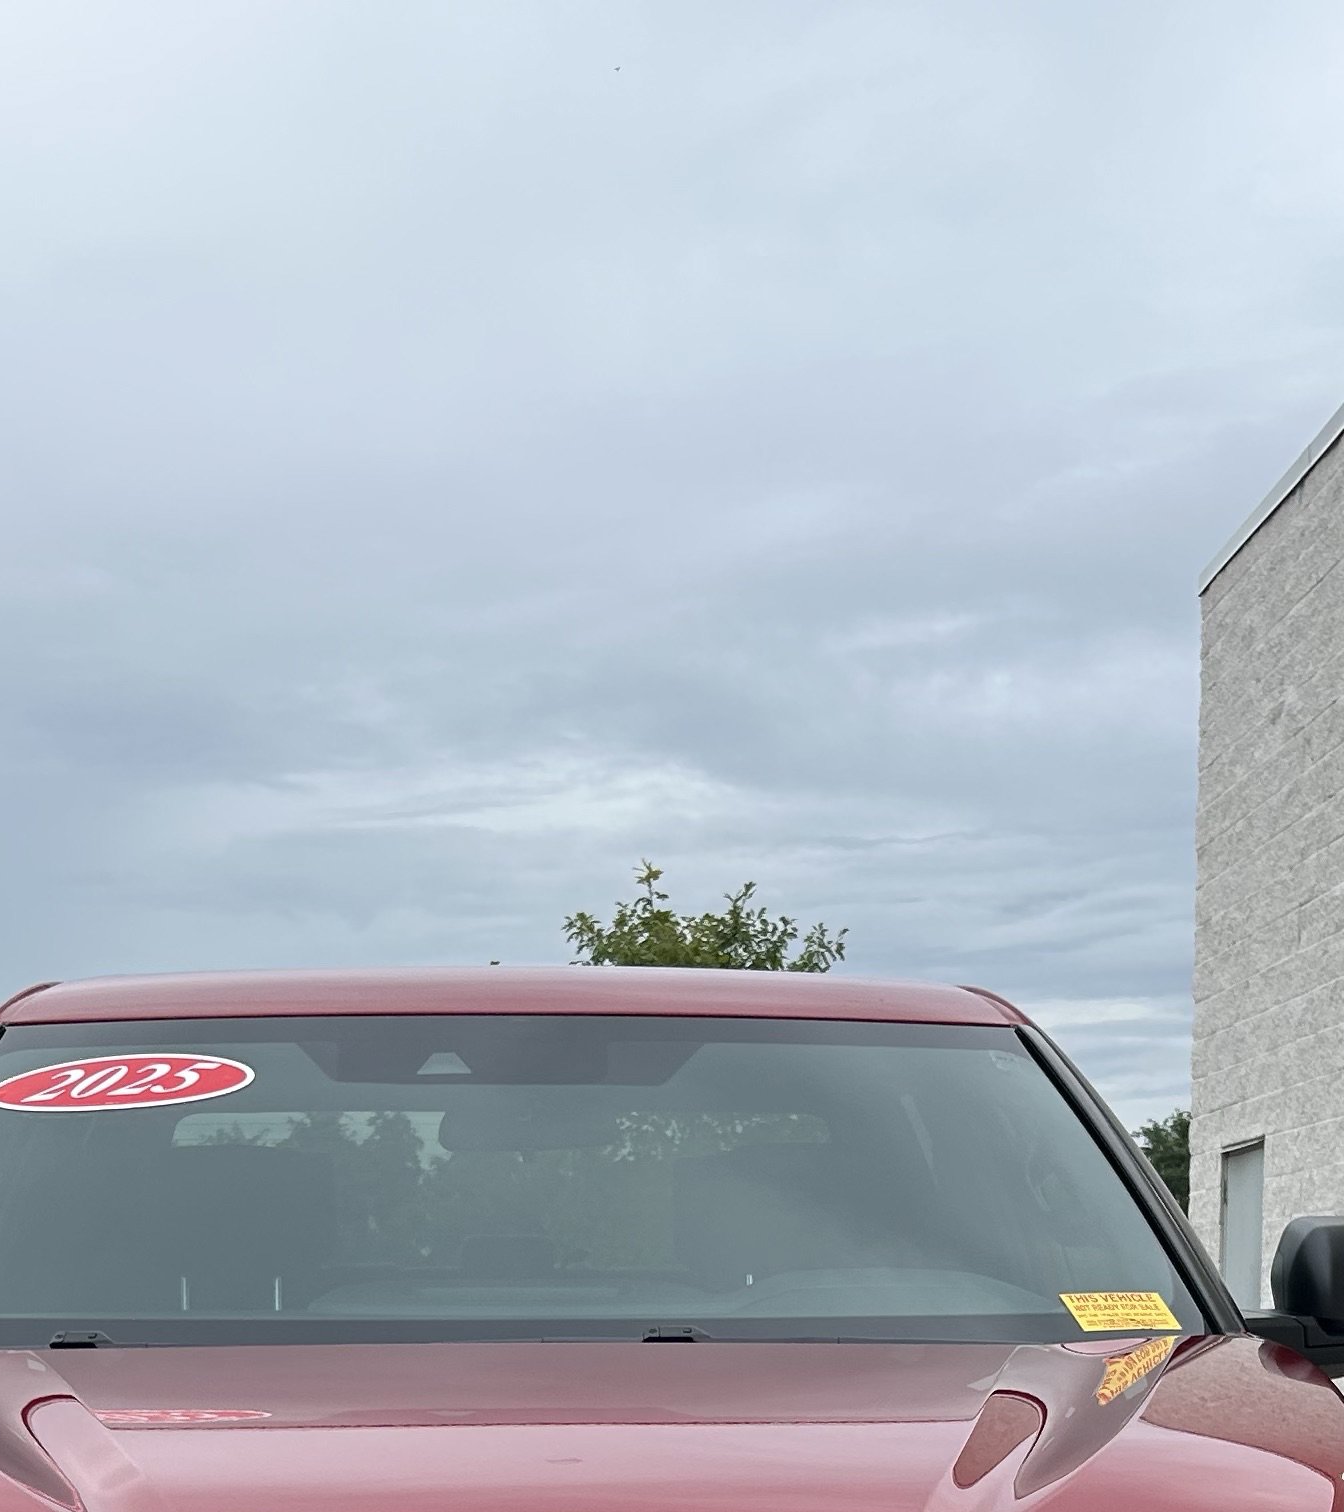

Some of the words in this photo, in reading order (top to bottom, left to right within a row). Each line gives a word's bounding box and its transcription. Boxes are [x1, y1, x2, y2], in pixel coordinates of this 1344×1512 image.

[19, 1061, 222, 1103] 2025
[1066, 1295, 1099, 1304] THIS
[1099, 1293, 1157, 1303] VEHICLE
